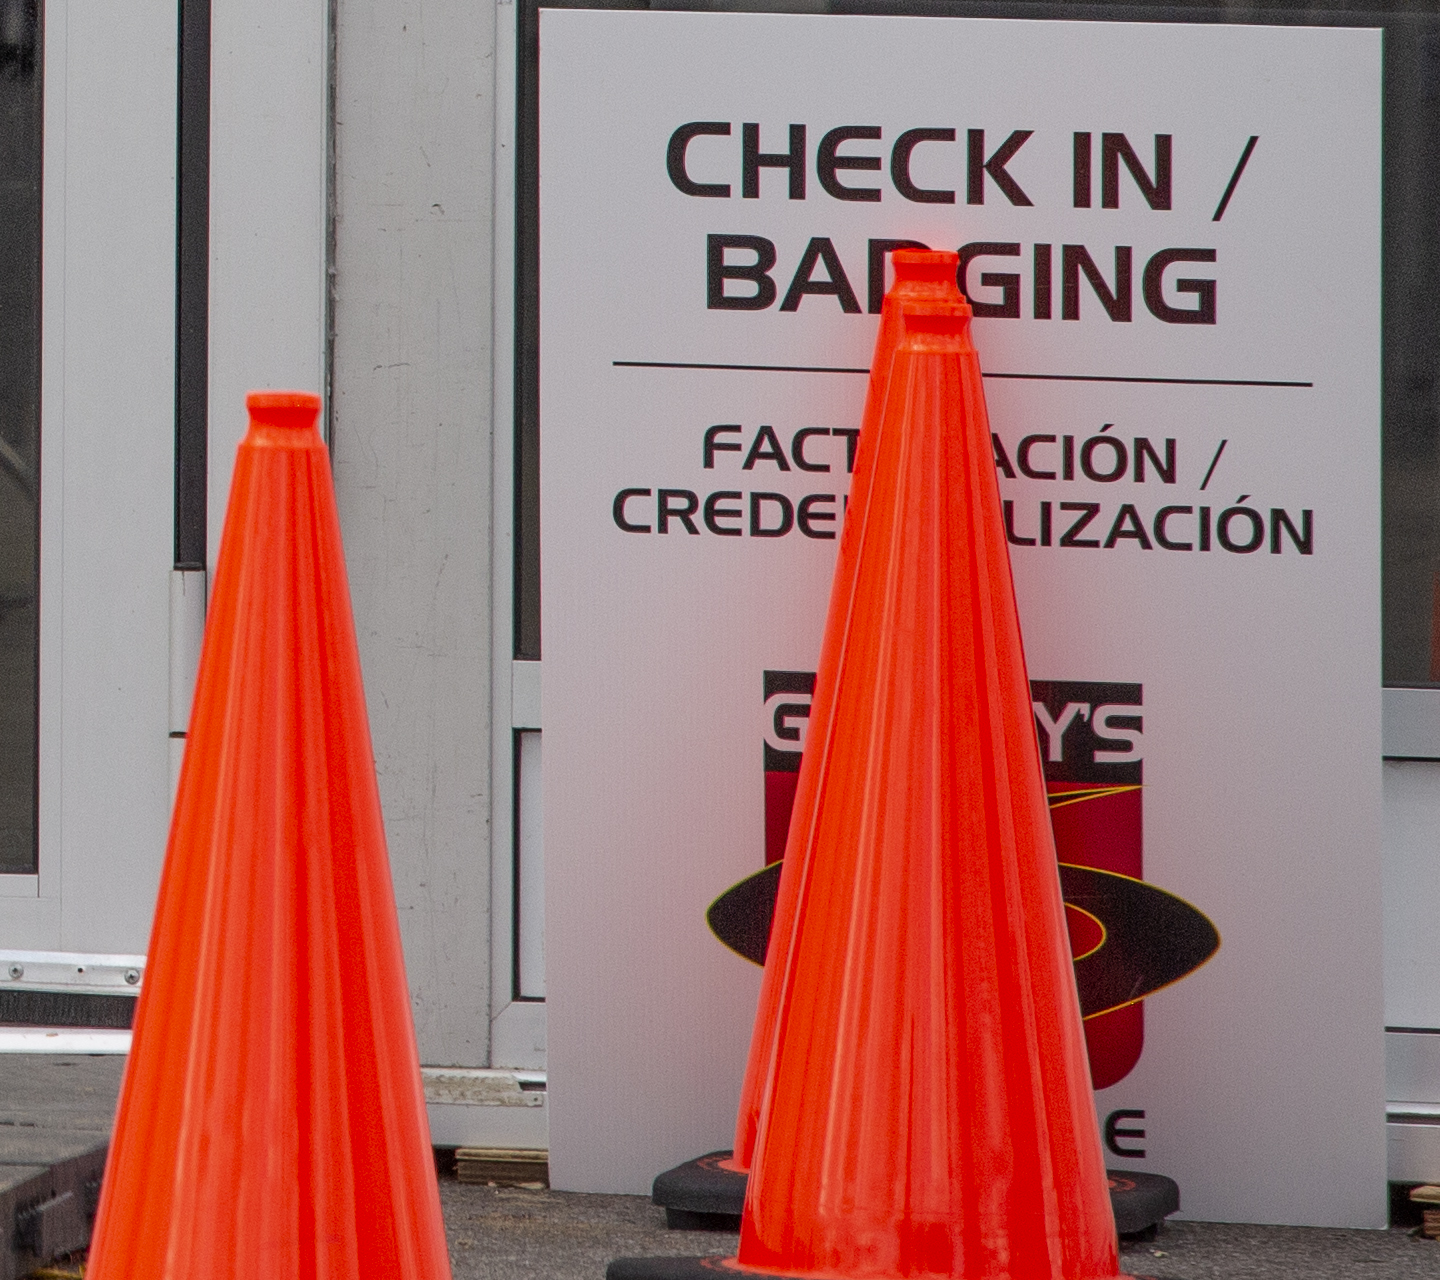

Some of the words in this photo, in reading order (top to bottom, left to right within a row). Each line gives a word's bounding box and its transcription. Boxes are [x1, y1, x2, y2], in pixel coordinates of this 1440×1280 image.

[666, 121, 1035, 207] CHECK
[1073, 131, 1172, 211] IN
[703, 423, 1176, 484] FACTCIÓN
[612, 488, 1314, 556] CREDELIZACIÓN
[763, 692, 1143, 763] GY'S
